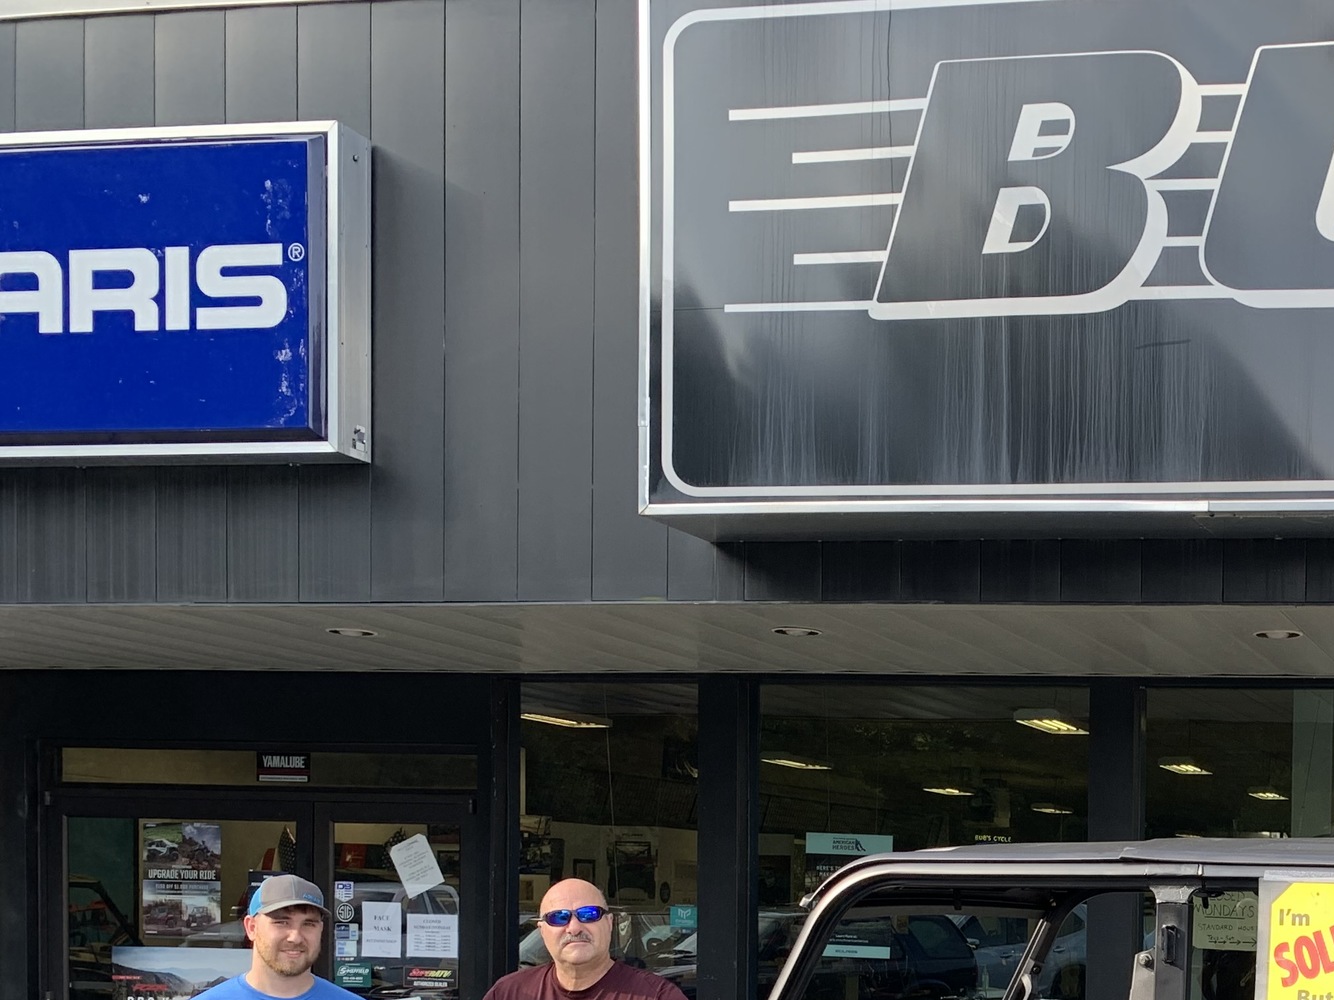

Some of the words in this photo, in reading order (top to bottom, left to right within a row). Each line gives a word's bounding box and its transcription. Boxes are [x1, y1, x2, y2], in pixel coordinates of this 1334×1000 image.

[262, 755, 305, 768] YAMALUBE
[148, 869, 178, 879] UPGRADE
[180, 870, 198, 879] YOUR
[200, 870, 216, 880] RIDE
[338, 906, 352, 918] SIG
[1279, 908, 1310, 926] I'm
[1198, 923, 1233, 931] STANDARD
